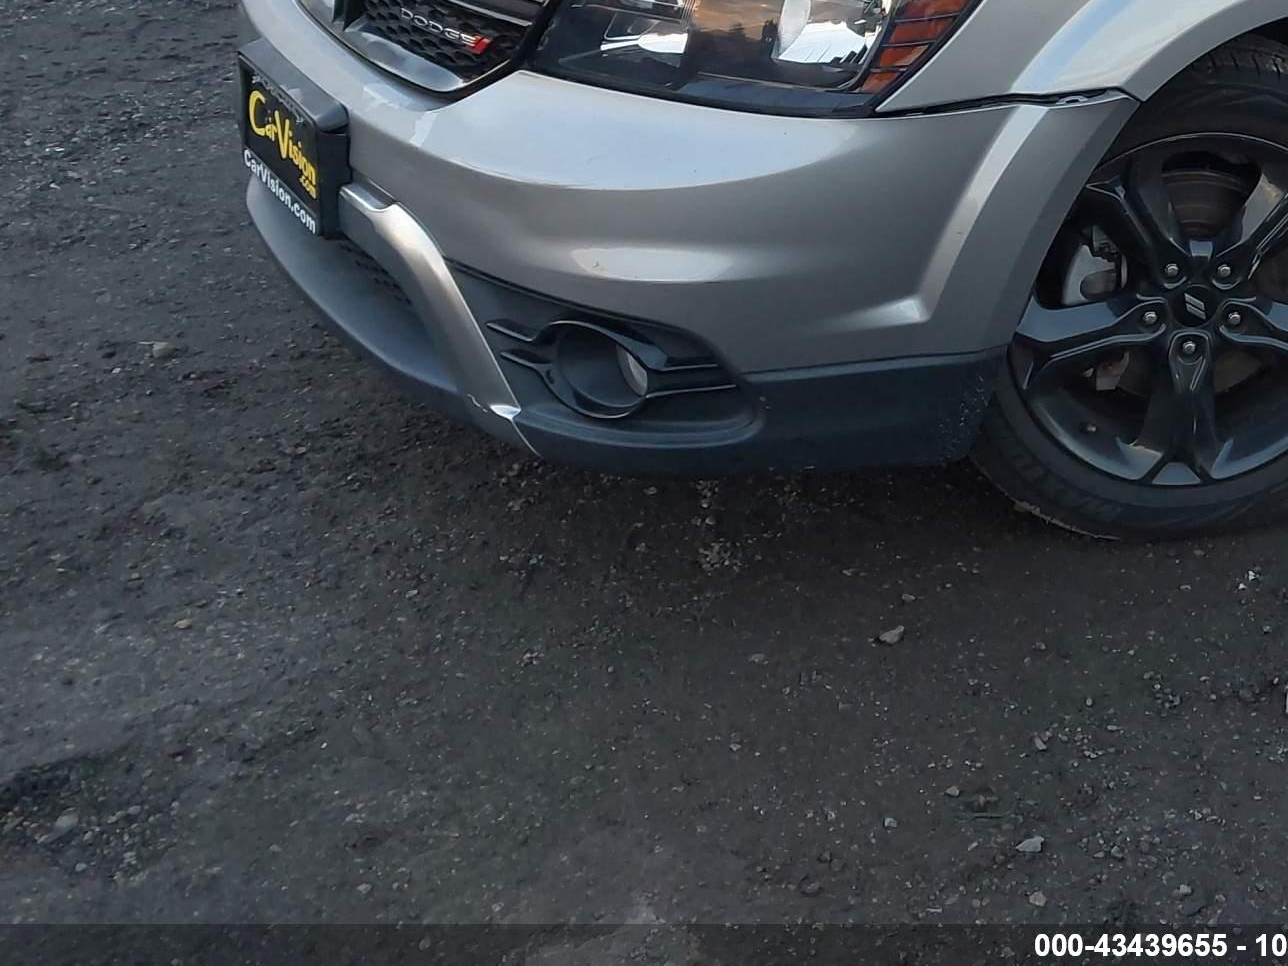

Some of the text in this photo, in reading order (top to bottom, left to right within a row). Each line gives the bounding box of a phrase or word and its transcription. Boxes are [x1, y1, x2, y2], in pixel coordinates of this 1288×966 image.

[400, 7, 478, 48] DODGE
[248, 89, 317, 185] CarVision
[243, 147, 317, 235] CarVision.com
